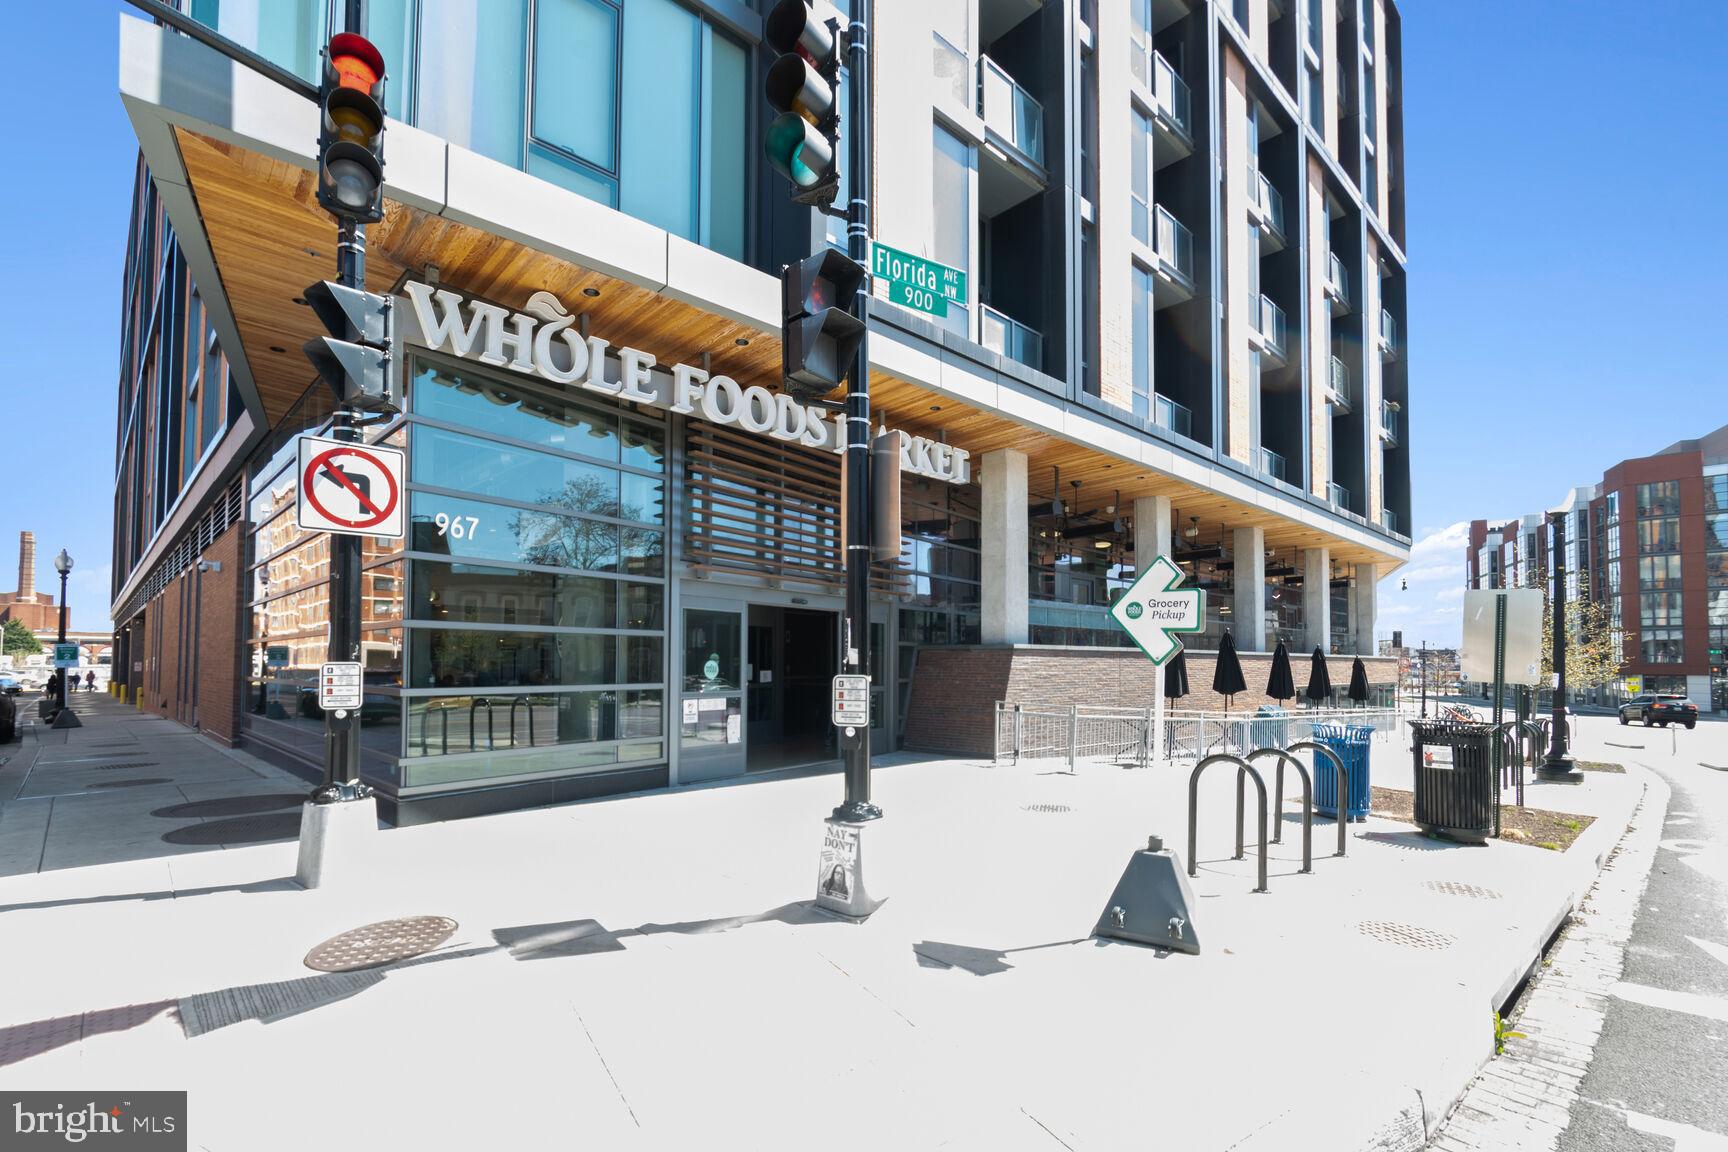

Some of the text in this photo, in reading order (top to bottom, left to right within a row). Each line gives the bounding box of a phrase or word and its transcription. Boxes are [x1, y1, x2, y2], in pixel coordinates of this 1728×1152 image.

[876, 247, 959, 291] Florida AVE
[904, 286, 933, 311] 900
[944, 284, 957, 300] NW
[403, 280, 971, 485] WHOLE FOODS RKET
[435, 512, 479, 540] 967
[1148, 598, 1190, 609] Grocery
[1151, 610, 1186, 621] Pickup
[826, 826, 848, 840] NAY
[824, 836, 856, 853] DON'T
